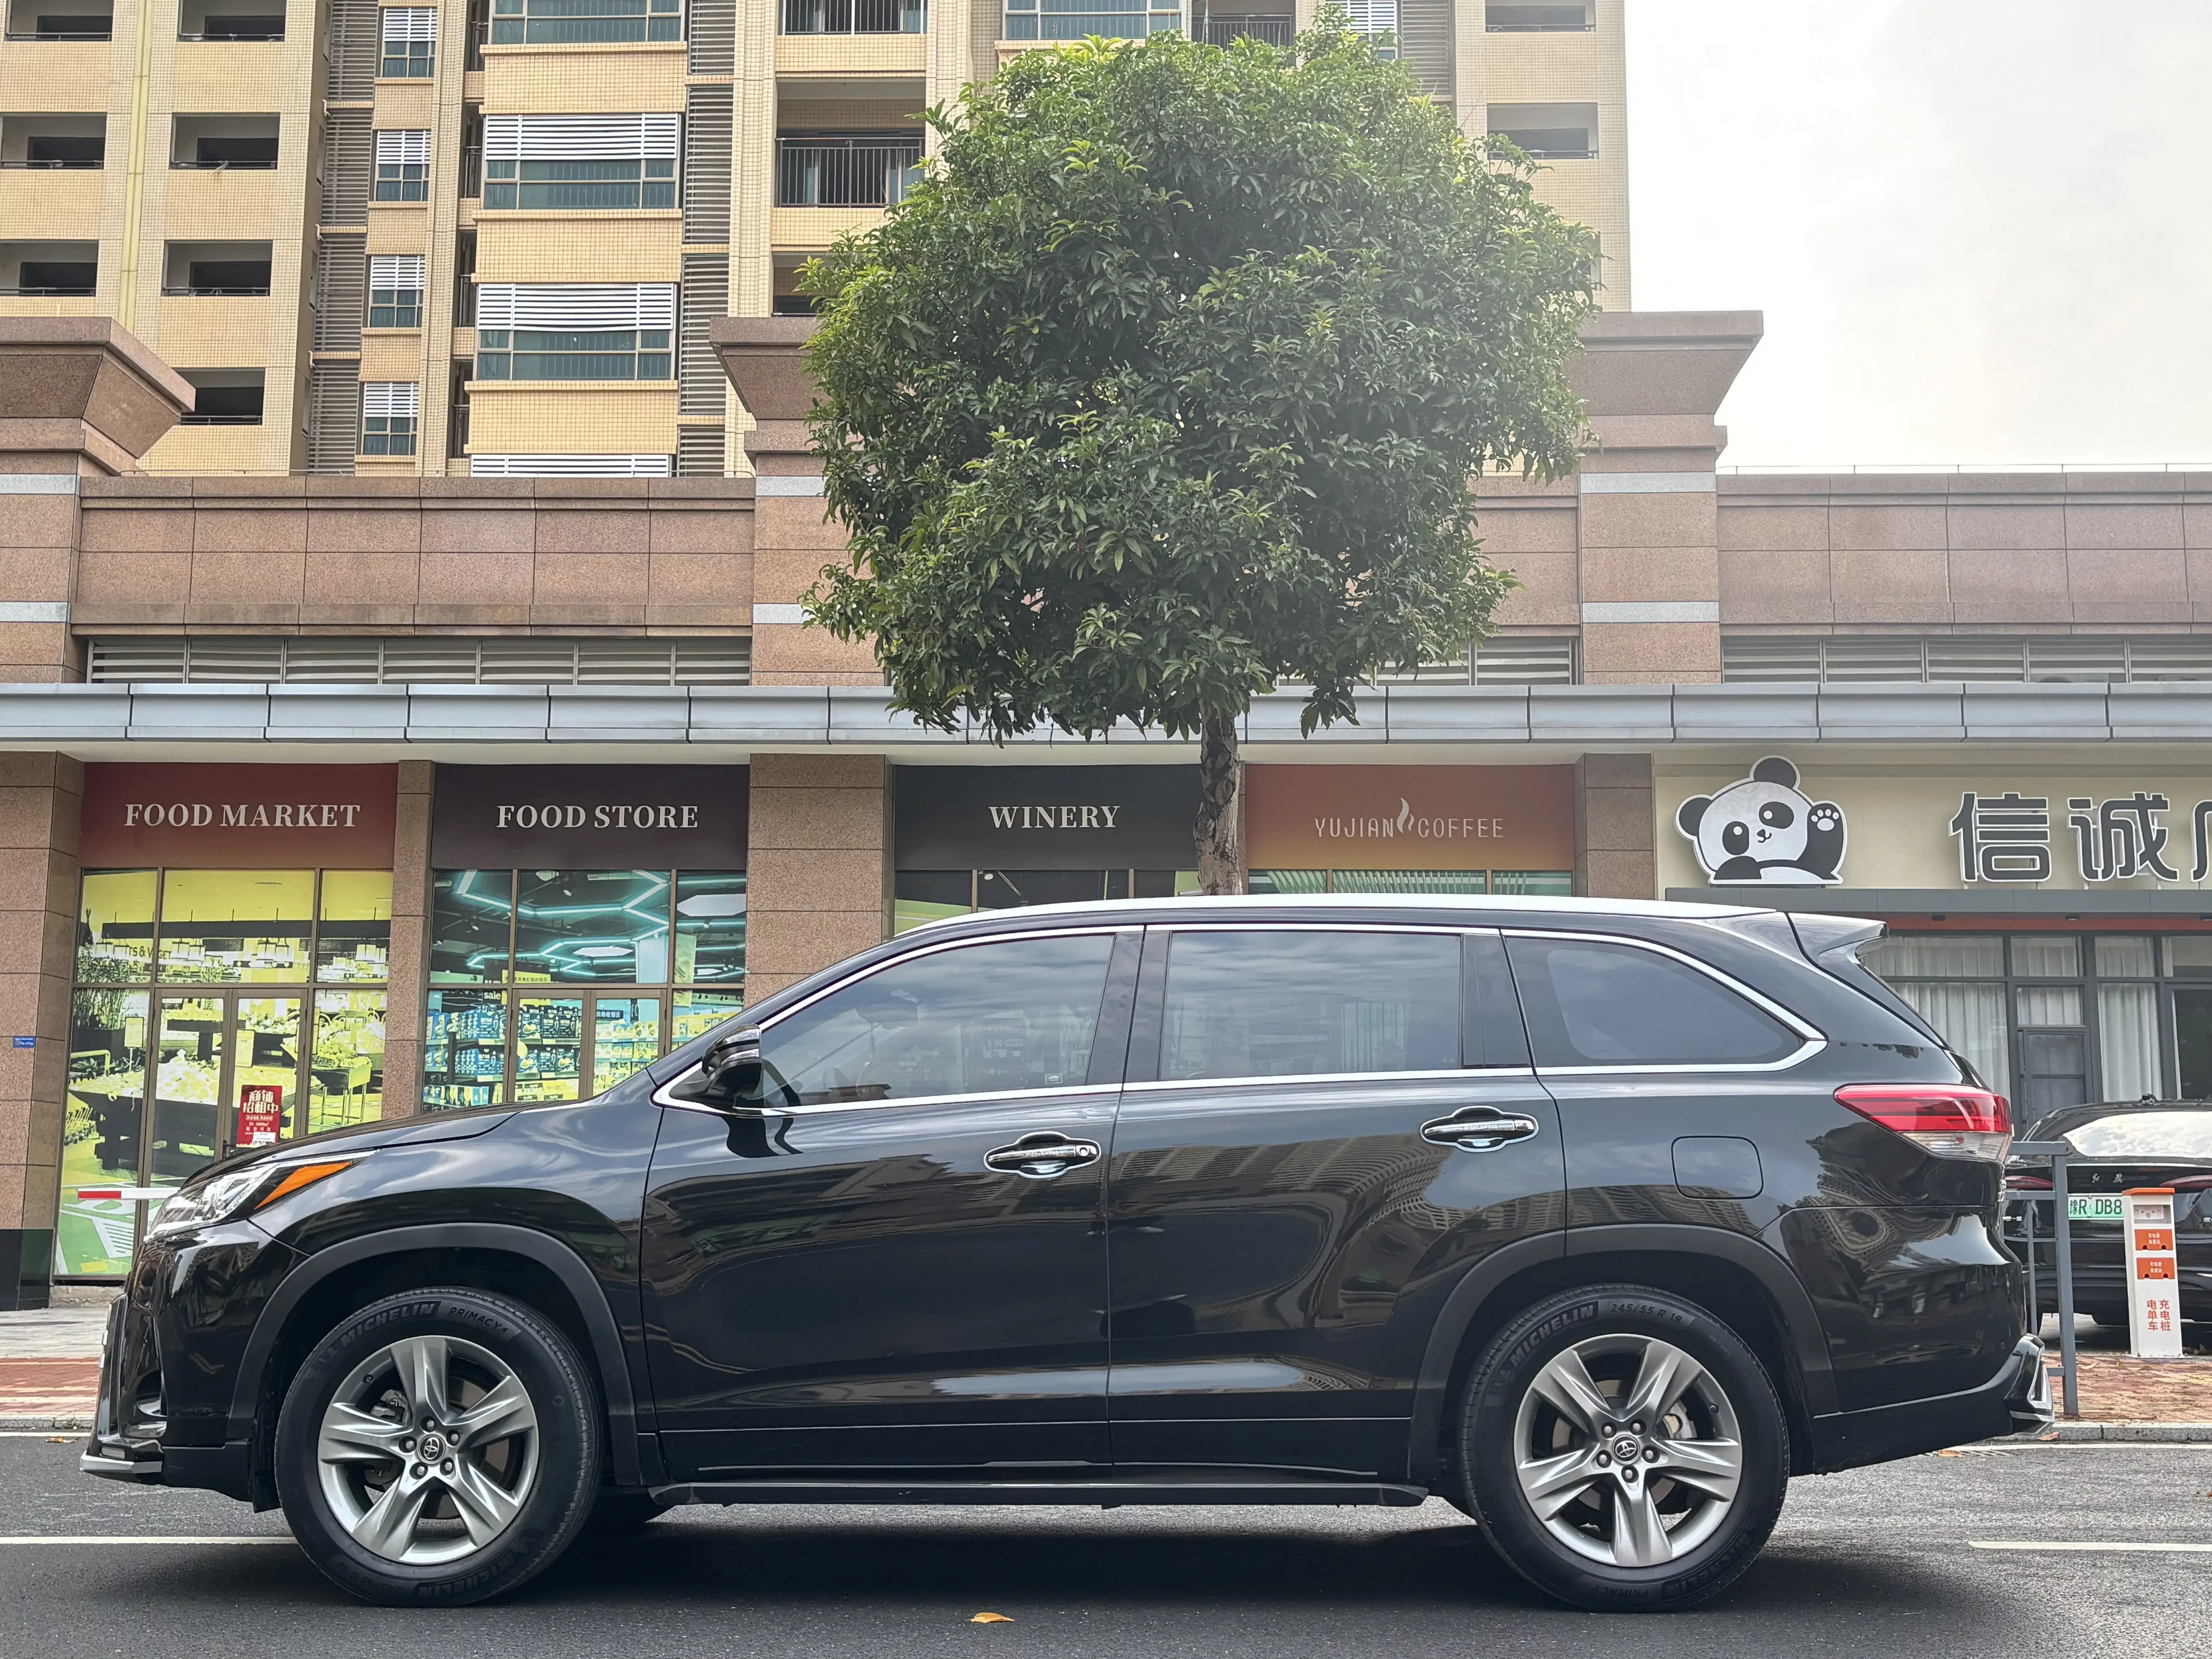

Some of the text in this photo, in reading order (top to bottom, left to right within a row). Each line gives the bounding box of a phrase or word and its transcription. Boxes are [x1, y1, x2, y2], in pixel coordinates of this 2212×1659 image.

[124, 804, 360, 827] FOOD MARKET
[496, 805, 698, 828] FOOD STORE
[988, 805, 1120, 828] WINERY
[1314, 818, 1503, 837] YUJIAN COFFEE
[1949, 792, 2212, 882] 信诚
[484, 991, 501, 1000] sale
[249, 1089, 274, 1103] 商铺
[243, 1102, 278, 1114] 招租中
[340, 1303, 434, 1348] MICHELIN
[448, 1307, 503, 1333] PRIMACY
[2147, 1299, 2158, 1331] 电单车
[2159, 1299, 2171, 1331] 充电桩
[1509, 1304, 1594, 1367] MICHELIN
[1610, 1304, 1654, 1314] 245/55
[1657, 1309, 1666, 1318] R
